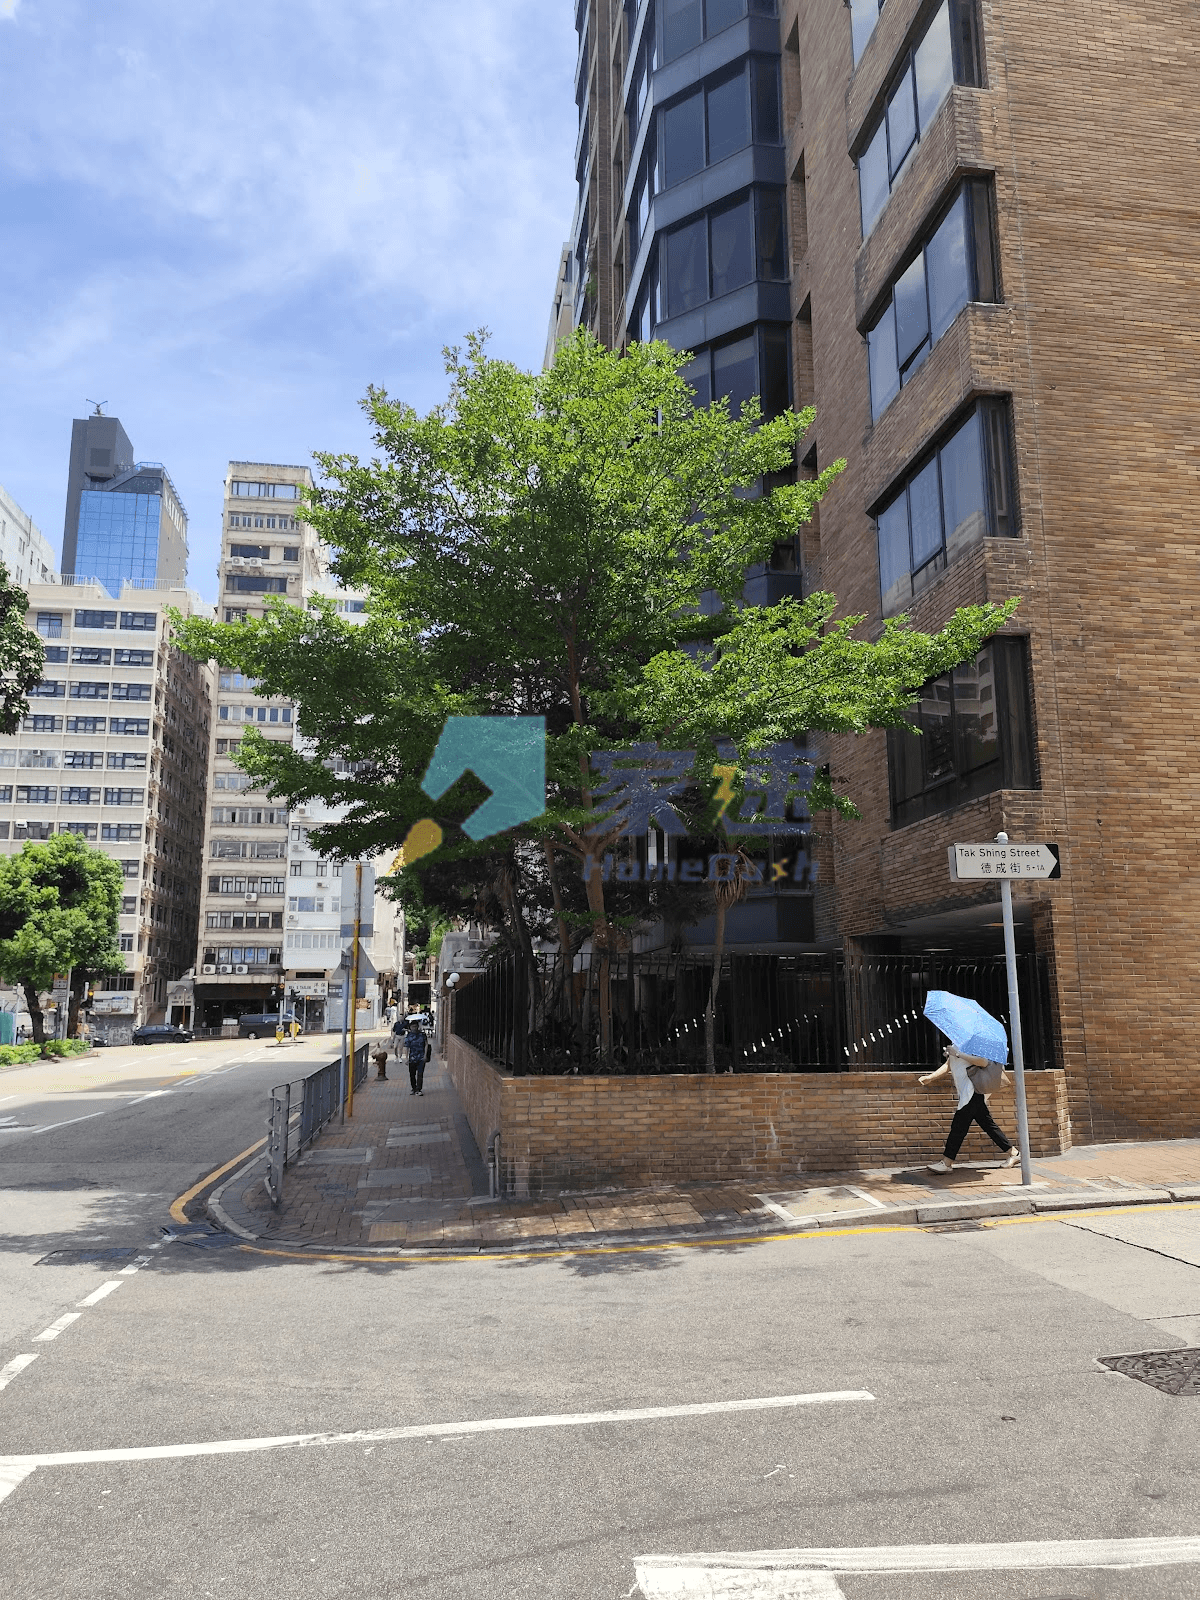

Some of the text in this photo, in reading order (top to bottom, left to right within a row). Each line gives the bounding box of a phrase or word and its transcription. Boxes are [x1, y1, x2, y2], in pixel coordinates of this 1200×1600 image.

[959, 848, 1040, 859] Tak Shing Street
[980, 862, 1021, 874] 德成街
